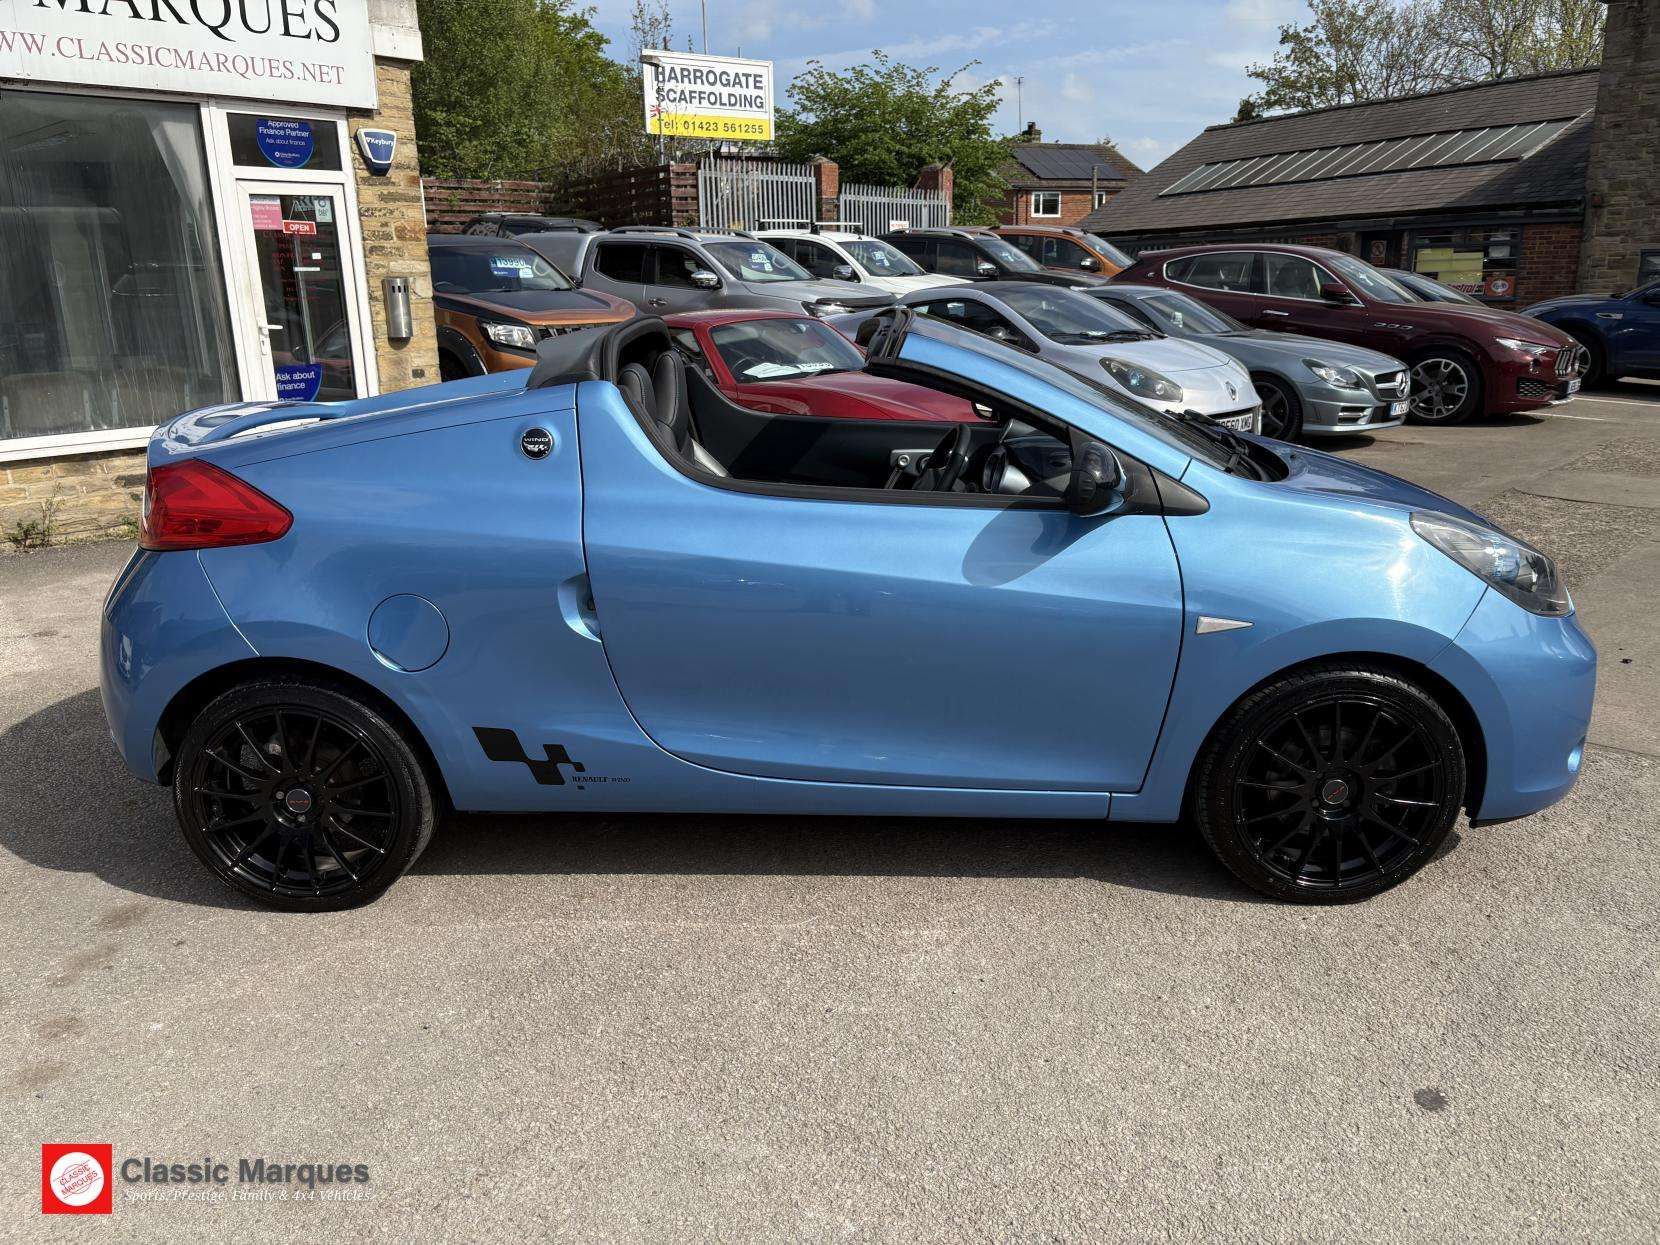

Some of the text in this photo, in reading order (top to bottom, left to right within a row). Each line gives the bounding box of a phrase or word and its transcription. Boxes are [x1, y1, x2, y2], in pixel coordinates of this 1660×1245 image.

[33, 0, 340, 43] QUES
[654, 66, 764, 90] HARROGATE
[656, 87, 764, 109] SCAFFOLDING
[267, 120, 299, 129] Approved
[683, 120, 719, 132] 01423
[723, 121, 764, 135] 561255
[259, 126, 310, 138] Finance Partner
[289, 223, 310, 232] OPEN
[276, 371, 315, 380] Ask about
[277, 382, 305, 390] finance
